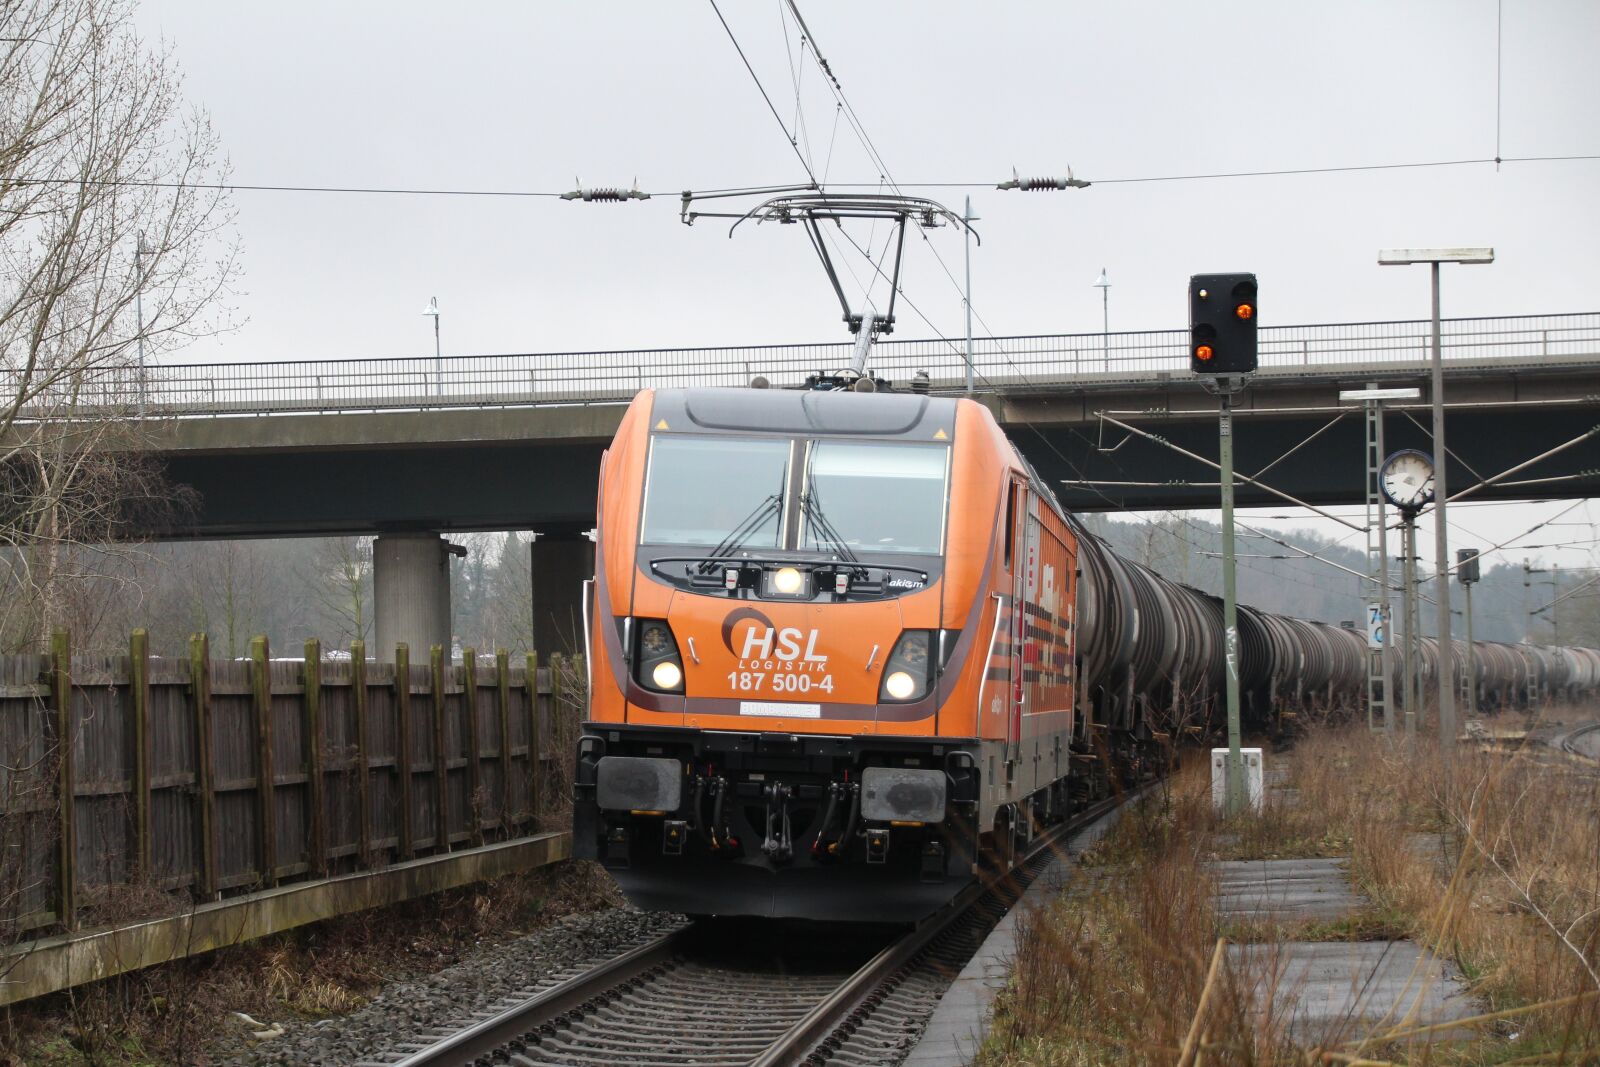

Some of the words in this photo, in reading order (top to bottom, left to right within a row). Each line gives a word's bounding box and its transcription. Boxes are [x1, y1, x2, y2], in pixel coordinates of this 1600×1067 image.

[888, 578, 924, 588] akiem
[741, 626, 828, 662] HSL
[738, 659, 826, 672] LOGISTIK
[727, 671, 766, 691] 187
[772, 673, 834, 694] 500-4
